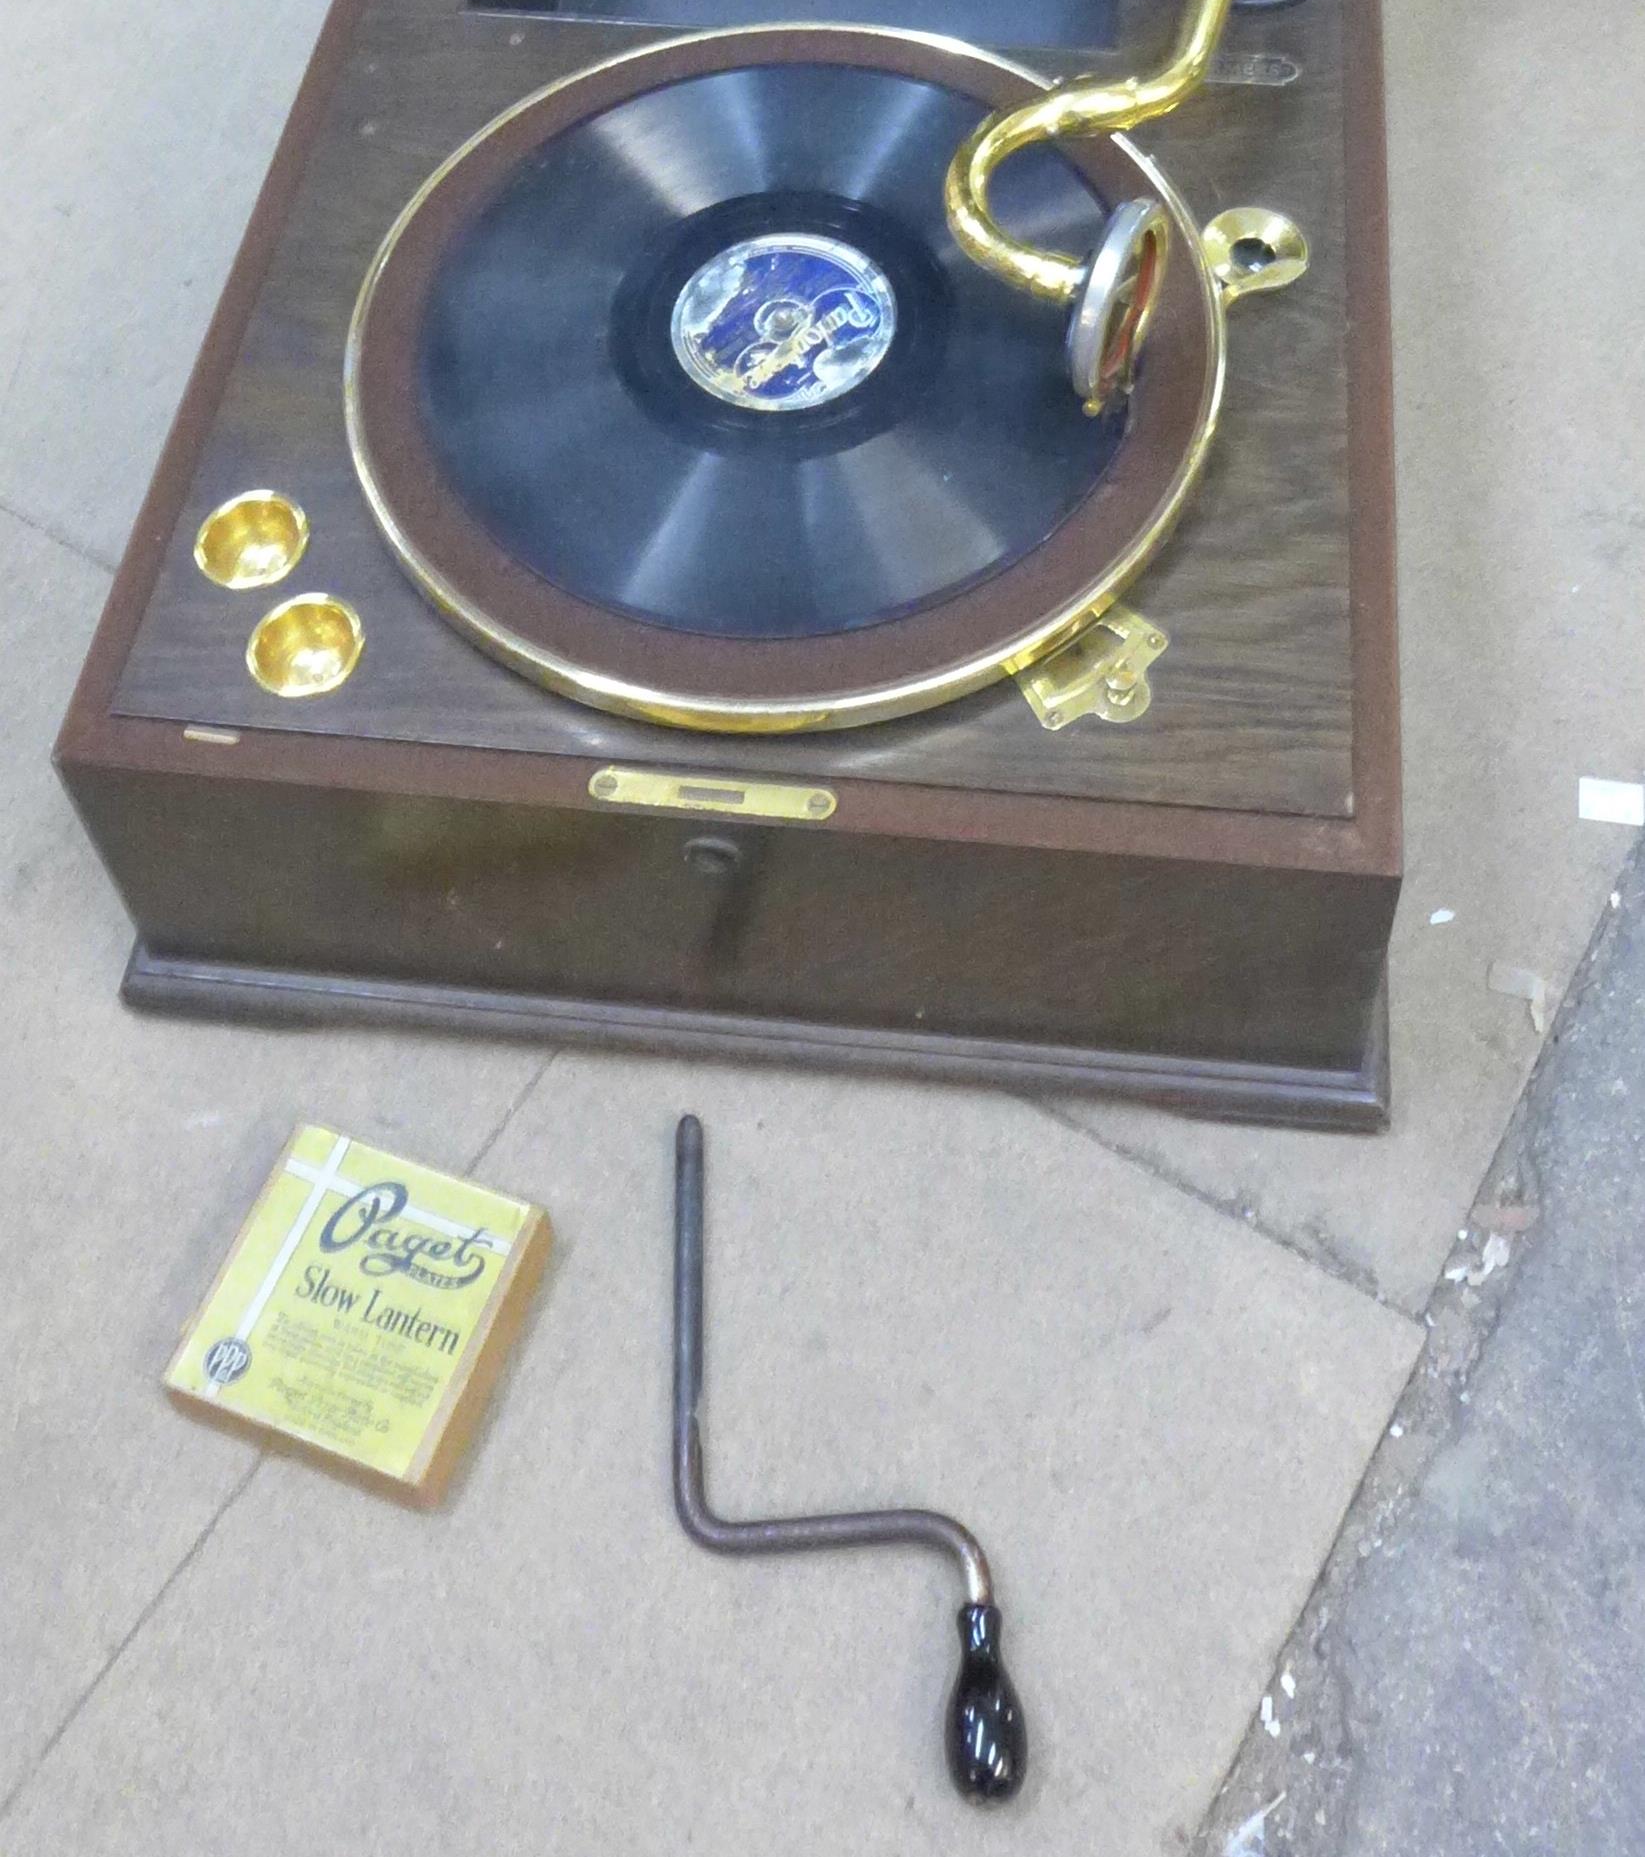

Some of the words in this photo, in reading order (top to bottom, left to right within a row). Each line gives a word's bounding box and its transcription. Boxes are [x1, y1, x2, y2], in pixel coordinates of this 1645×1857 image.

[319, 1181, 493, 1289] Paget
[294, 1265, 361, 1314] Slow
[362, 1289, 461, 1356] Lantern
